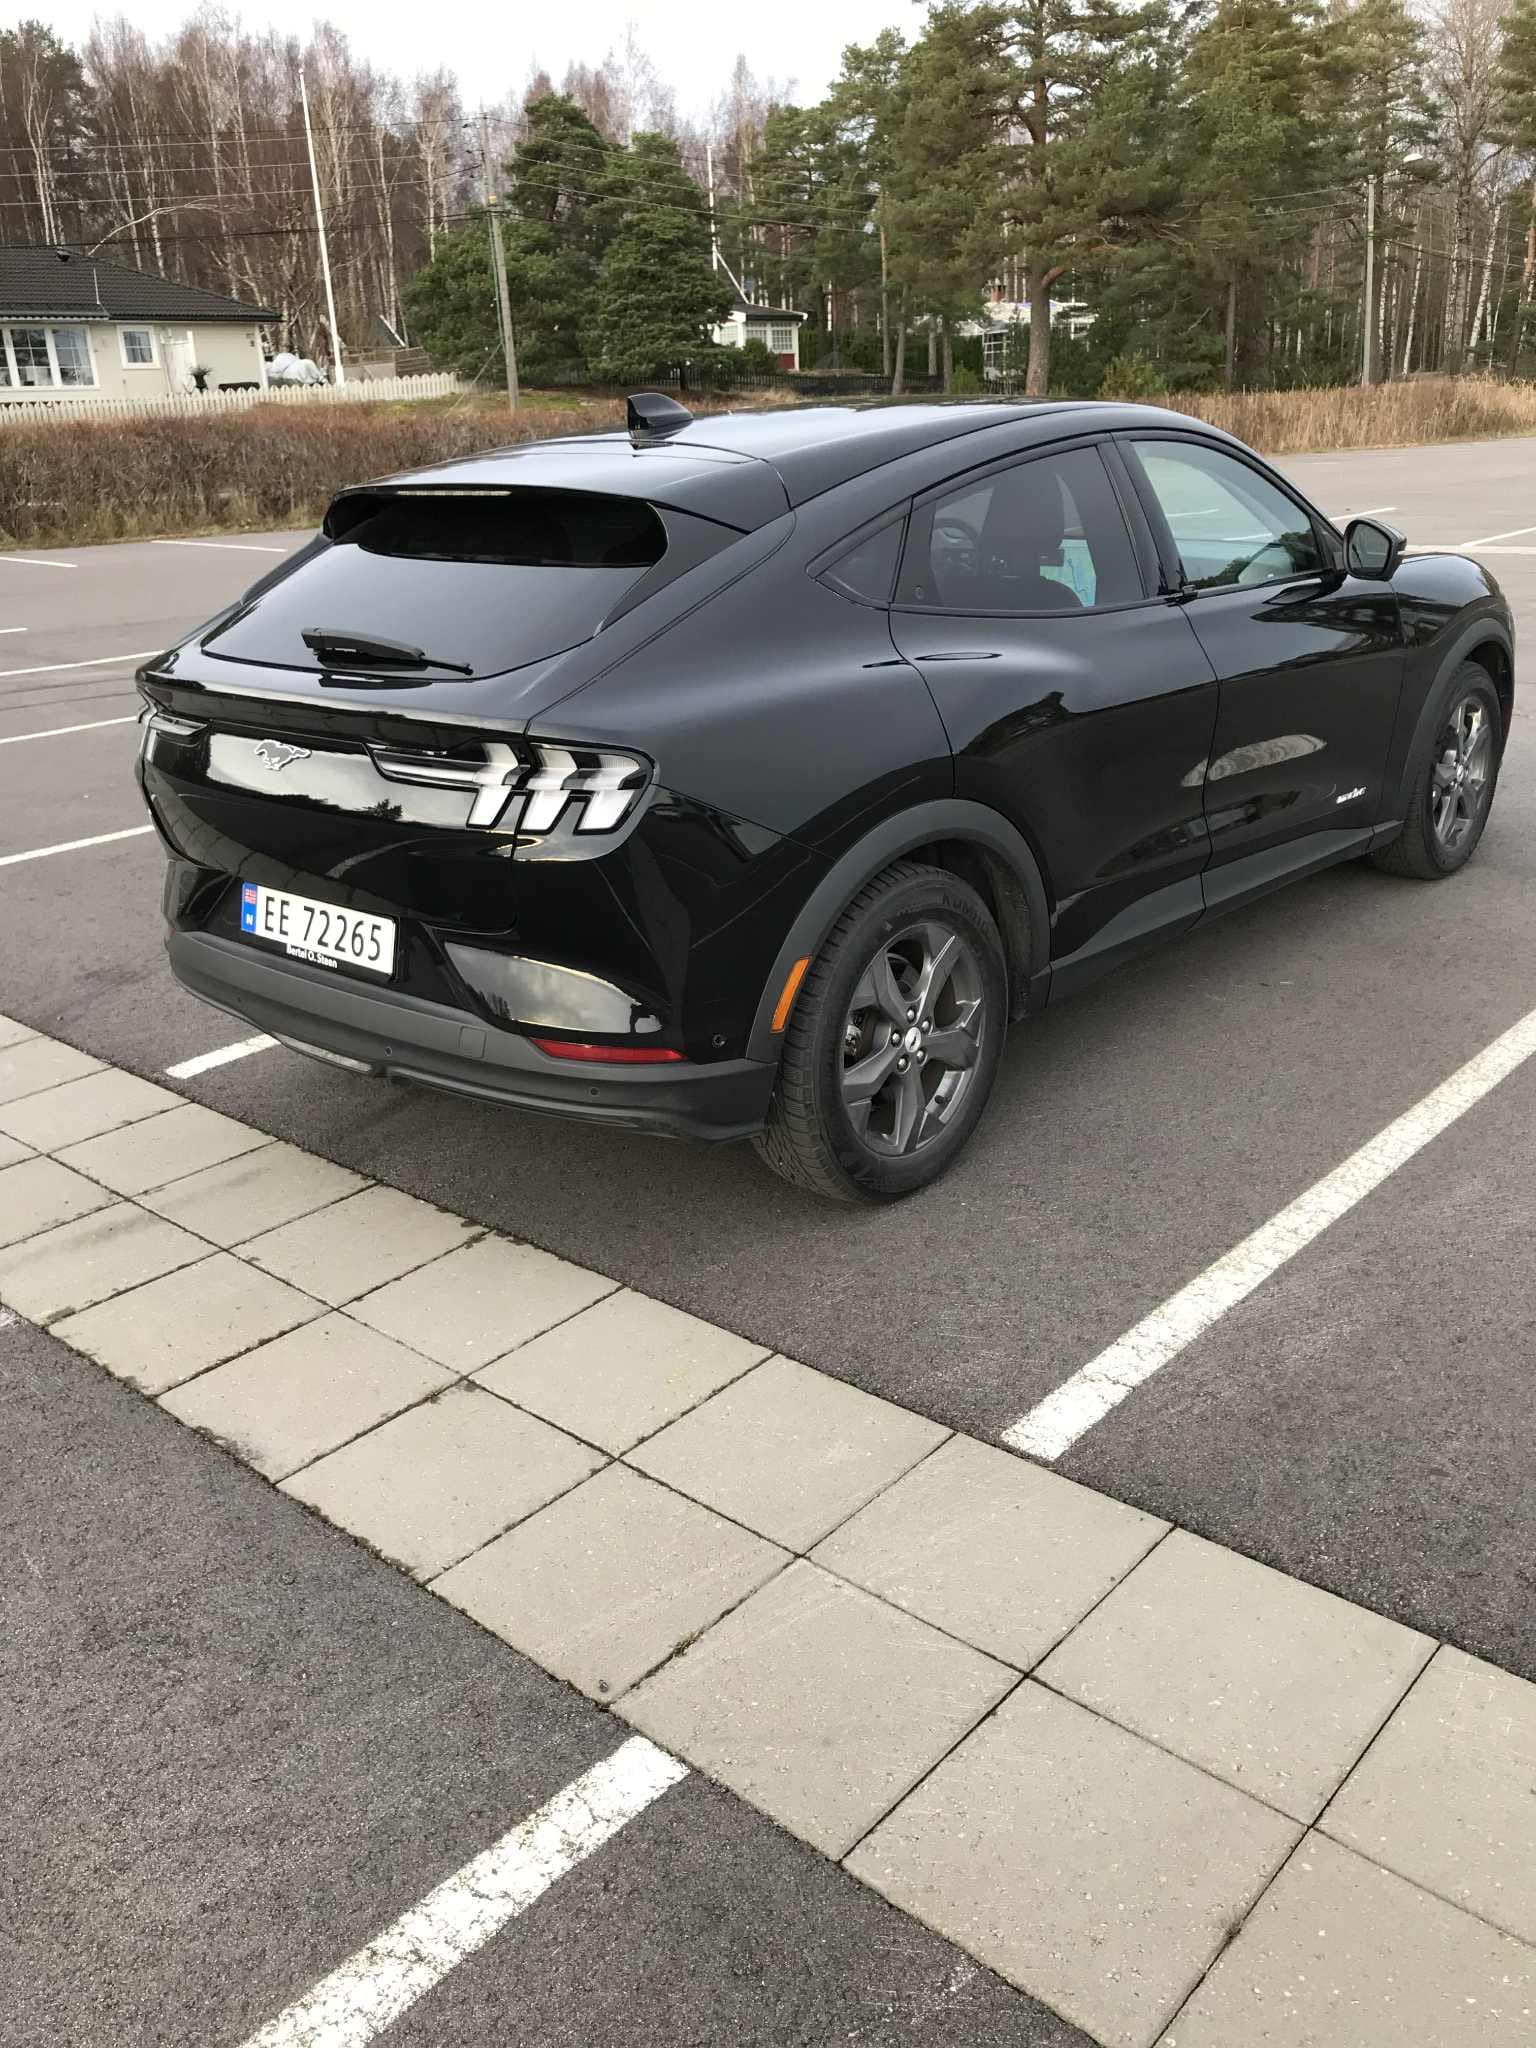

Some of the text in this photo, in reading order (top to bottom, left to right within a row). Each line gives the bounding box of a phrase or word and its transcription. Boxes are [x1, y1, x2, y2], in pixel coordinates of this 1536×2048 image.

[246, 912, 255, 926] N
[264, 895, 382, 962] EE 72265
[317, 951, 338, 969] Steen
